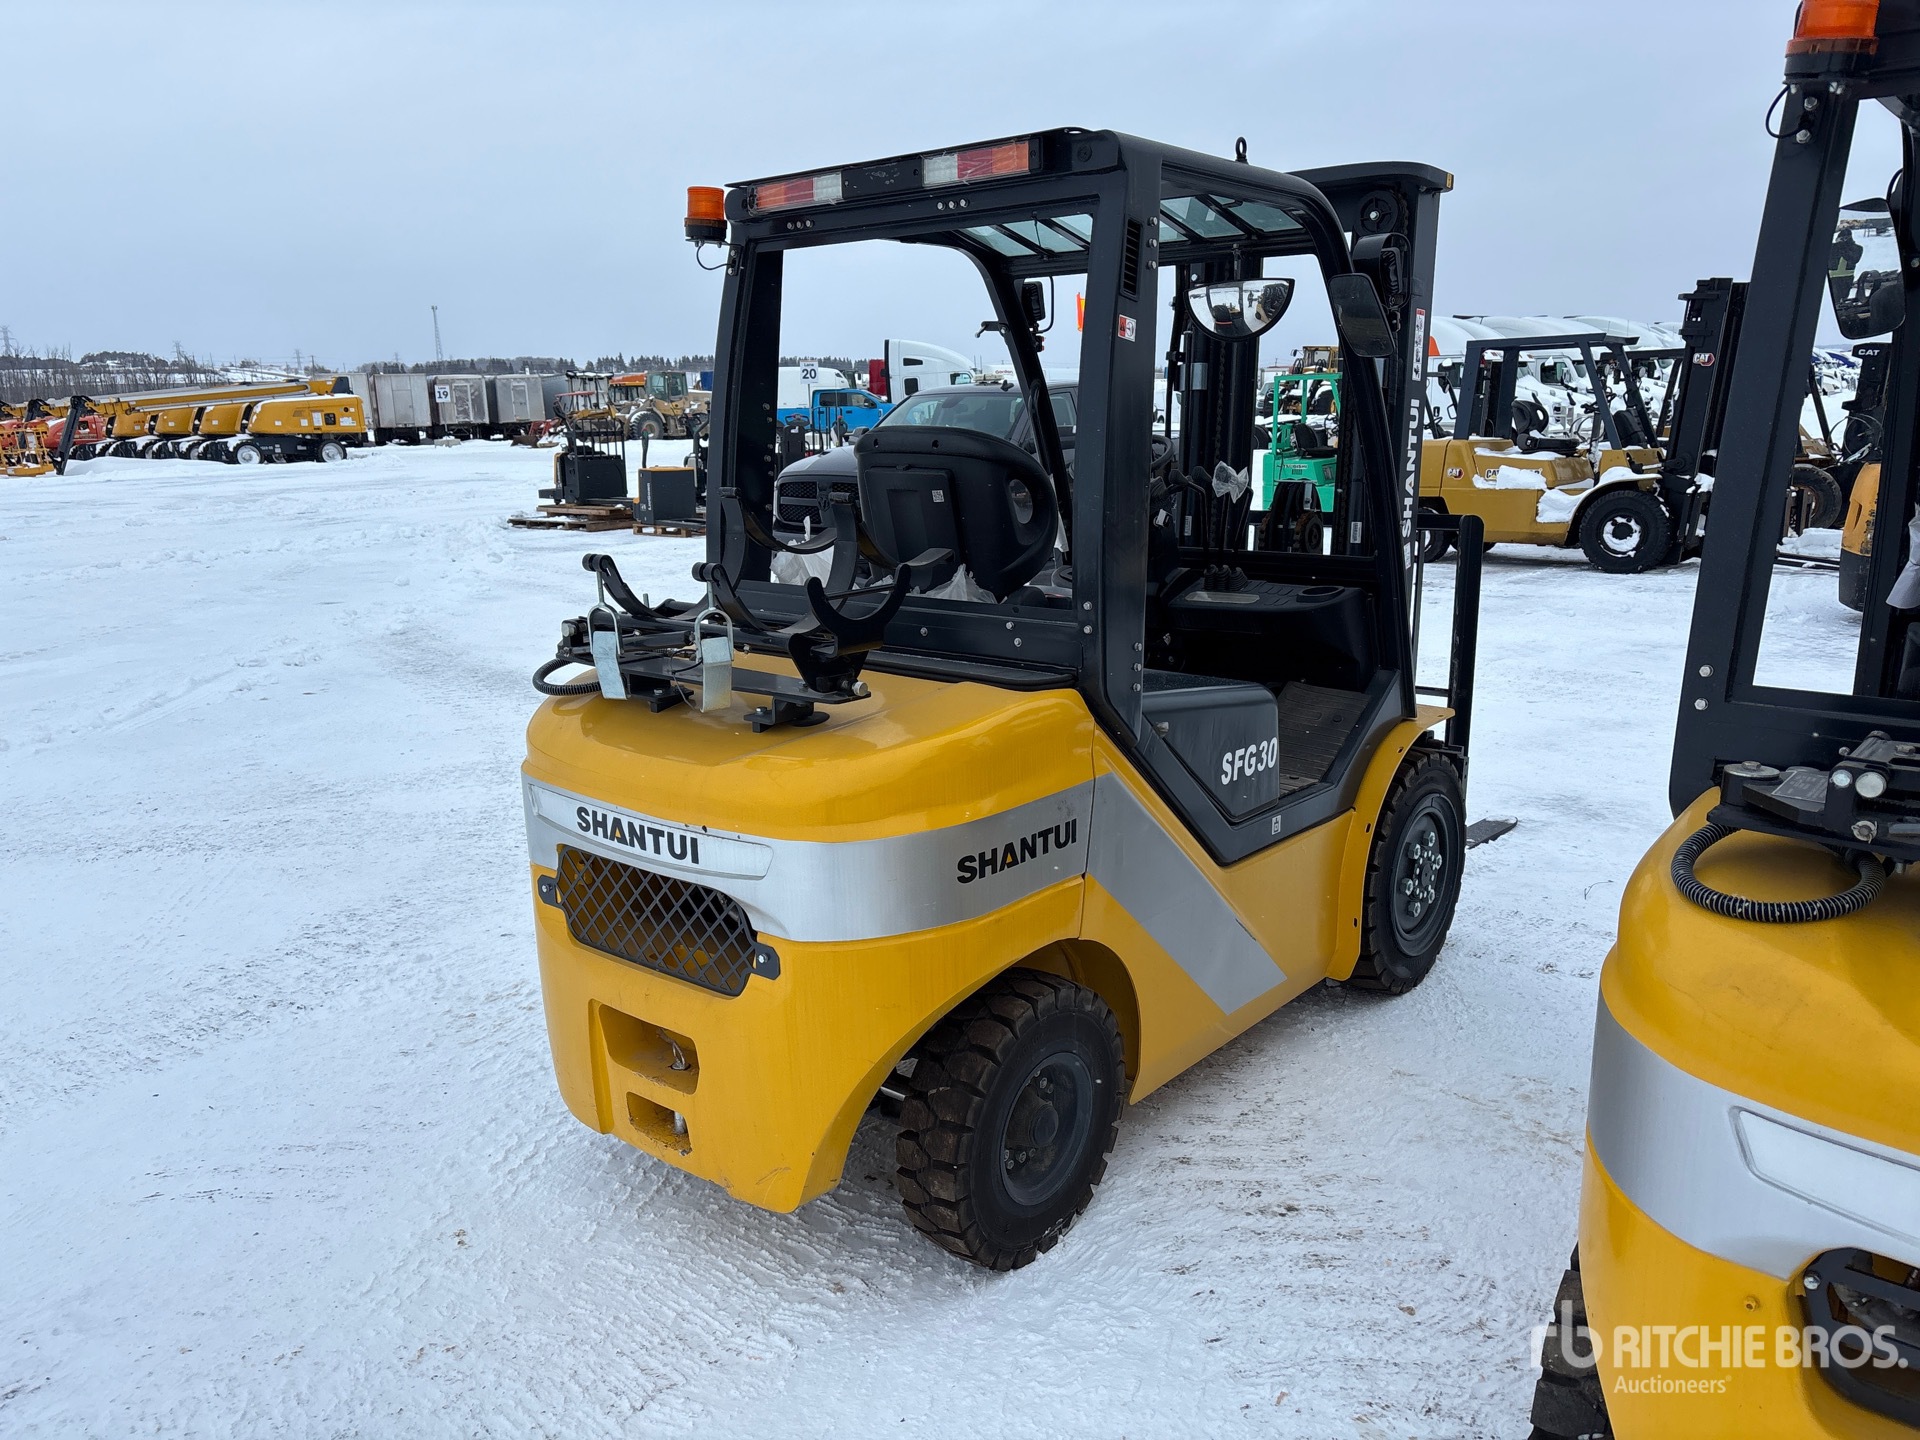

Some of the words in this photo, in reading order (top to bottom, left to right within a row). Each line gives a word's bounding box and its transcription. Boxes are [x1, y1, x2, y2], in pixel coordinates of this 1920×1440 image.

[1693, 352, 1710, 363] CAT
[1858, 348, 1880, 356] CAT
[801, 368, 817, 380] 20
[437, 390, 449, 399] 19
[1401, 398, 1420, 539] SHANTUI
[1221, 736, 1278, 786] SFG30
[576, 806, 699, 865] SHANTUI
[956, 818, 1077, 884] SHANTUI
